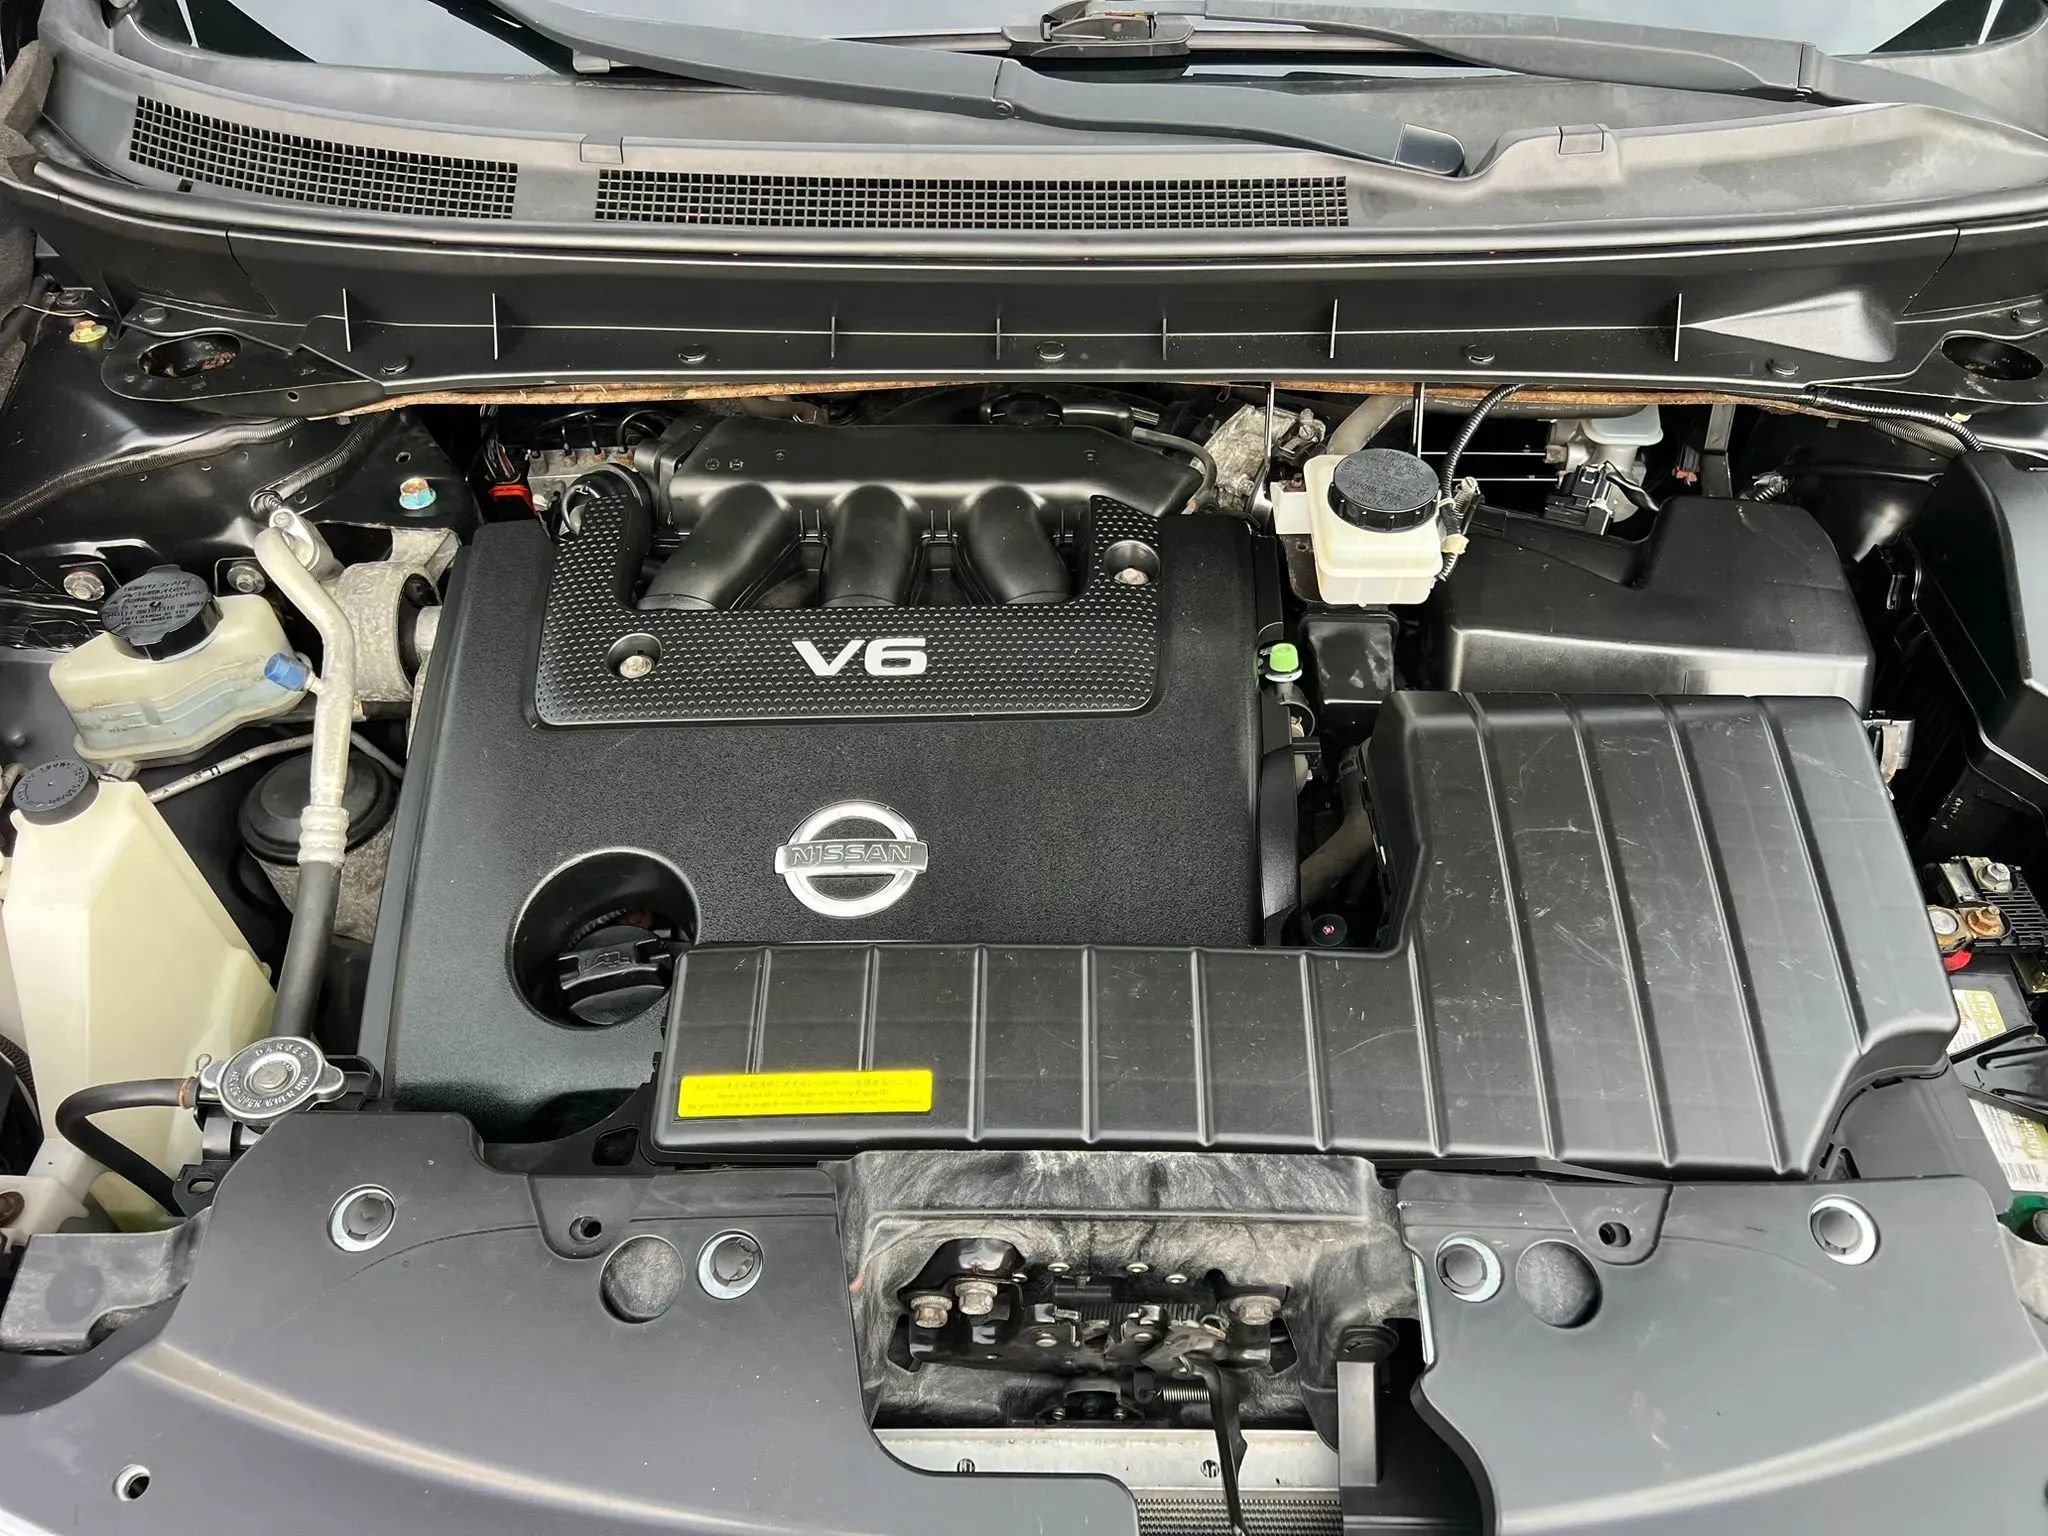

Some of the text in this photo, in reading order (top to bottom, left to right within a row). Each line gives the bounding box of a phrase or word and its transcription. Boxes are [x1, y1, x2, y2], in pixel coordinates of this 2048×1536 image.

[792, 637, 928, 677] V6
[791, 844, 913, 866] NISSAN
[255, 1042, 309, 1058] DANGER
